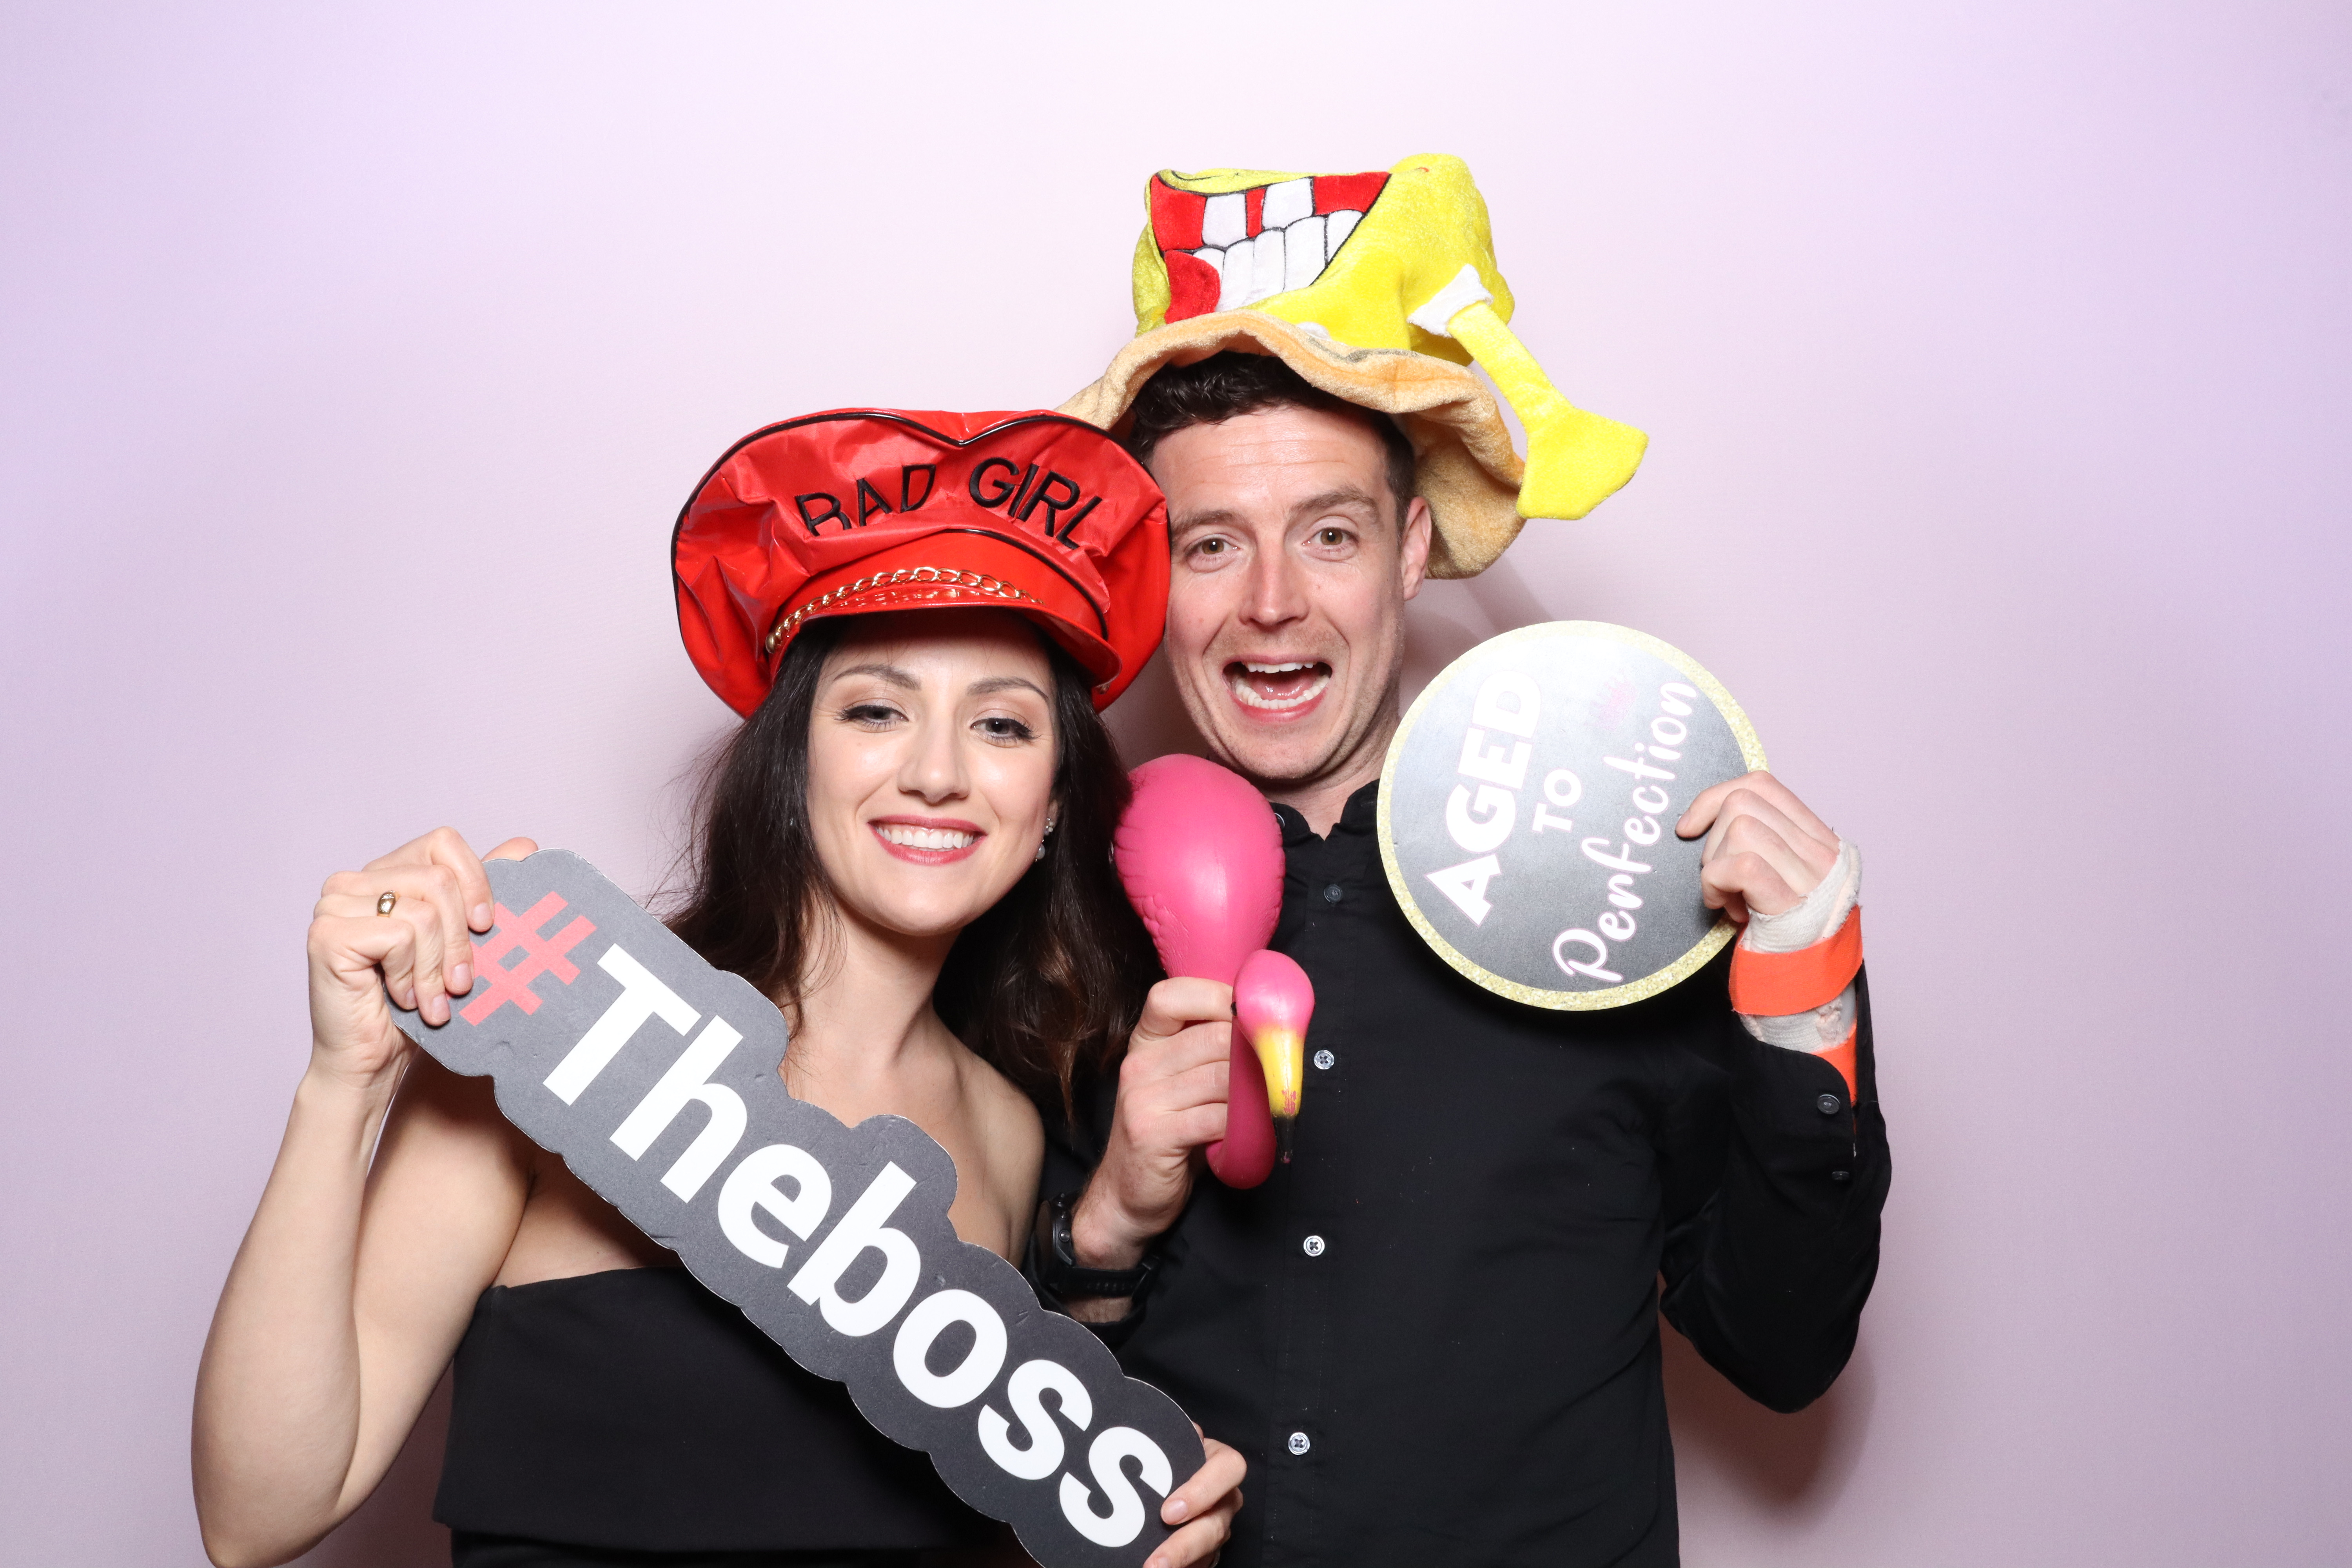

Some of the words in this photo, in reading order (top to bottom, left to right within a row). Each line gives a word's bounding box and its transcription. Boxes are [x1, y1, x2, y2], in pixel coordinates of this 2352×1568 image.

[969, 457, 1103, 550] GIRL
[1426, 670, 1541, 926] AGED
[1532, 769, 1582, 832] TO
[1553, 682, 1697, 981] Perfection
[447, 891, 1172, 1547] #Theboss
